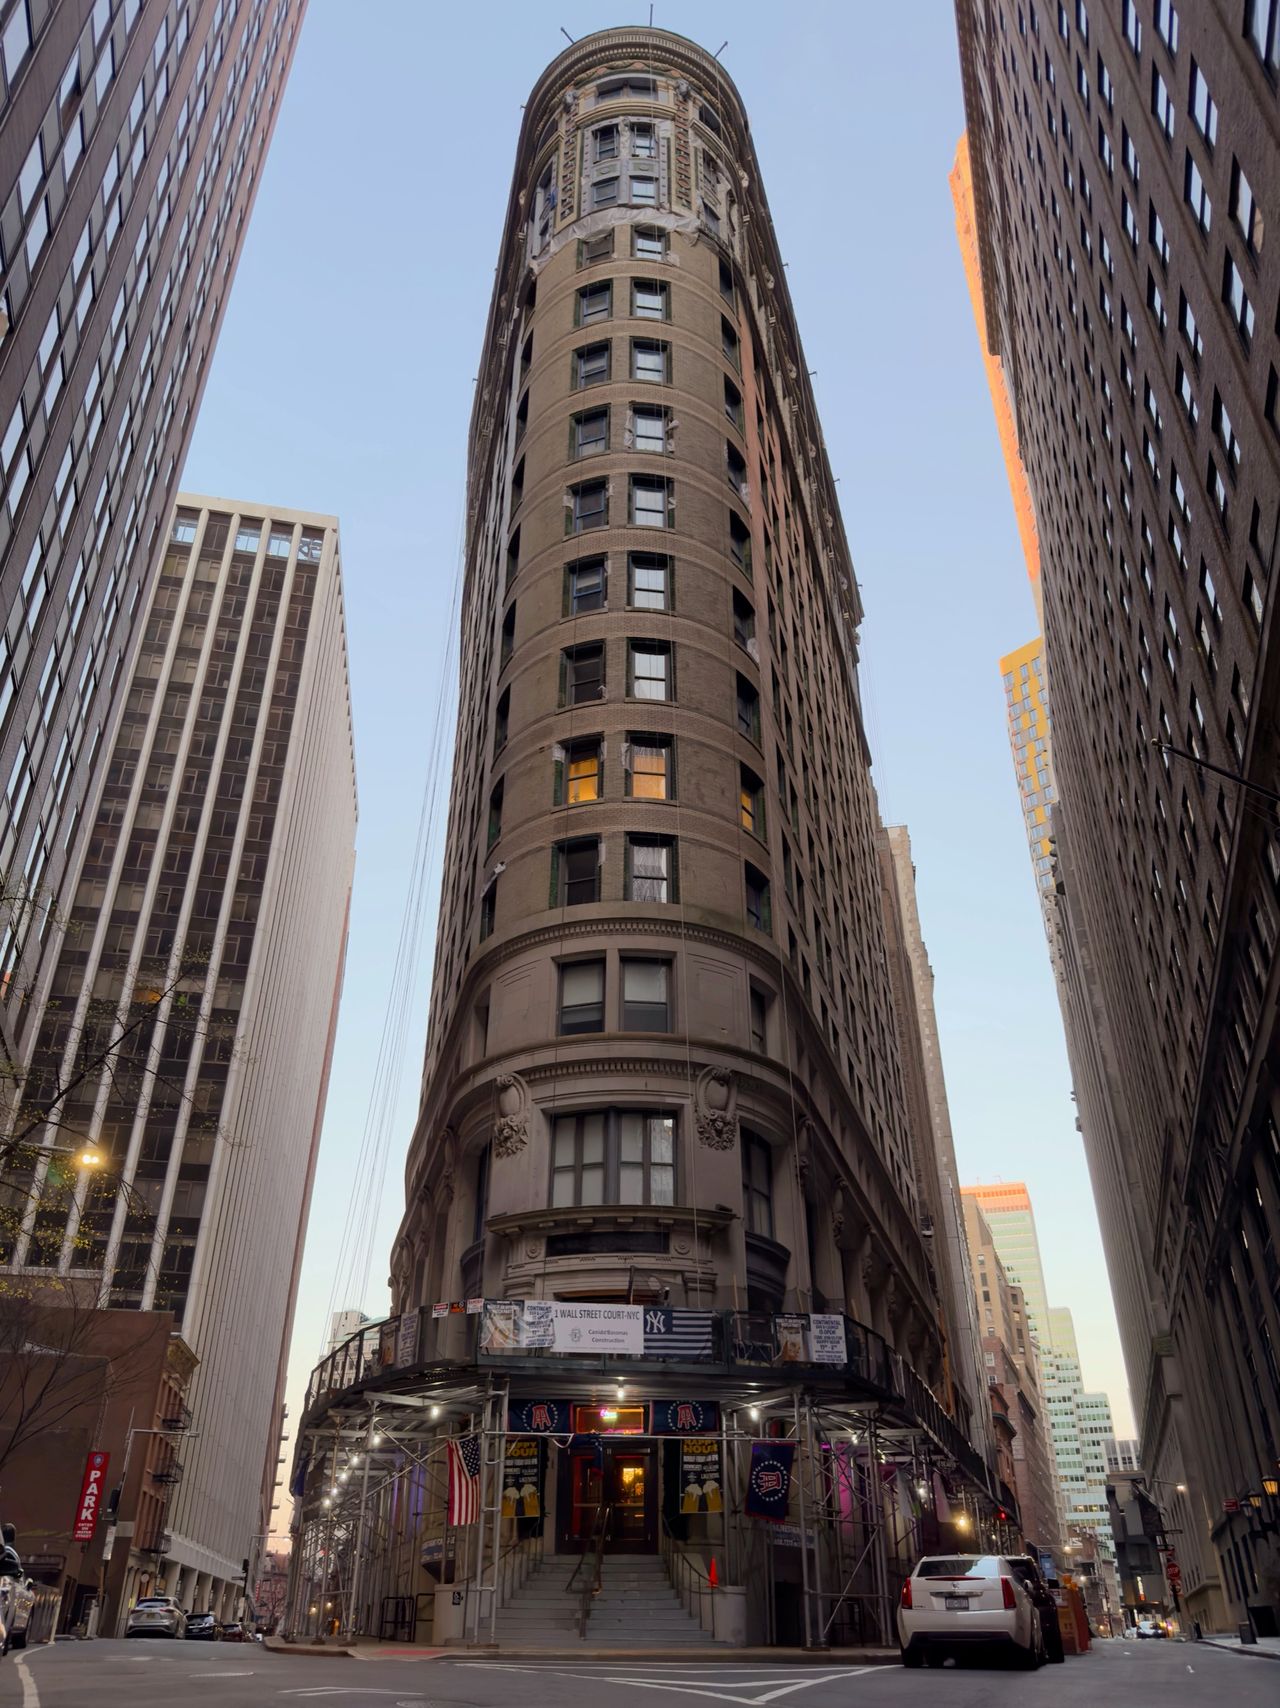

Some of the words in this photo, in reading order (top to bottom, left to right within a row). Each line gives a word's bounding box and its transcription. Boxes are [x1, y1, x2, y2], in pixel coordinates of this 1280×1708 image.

[555, 1310, 558, 1318] 1
[560, 1309, 578, 1319] WALL
[579, 1310, 601, 1319] STREET
[603, 1310, 640, 1320] COURT-NYC
[81, 1470, 101, 1520] PARK
